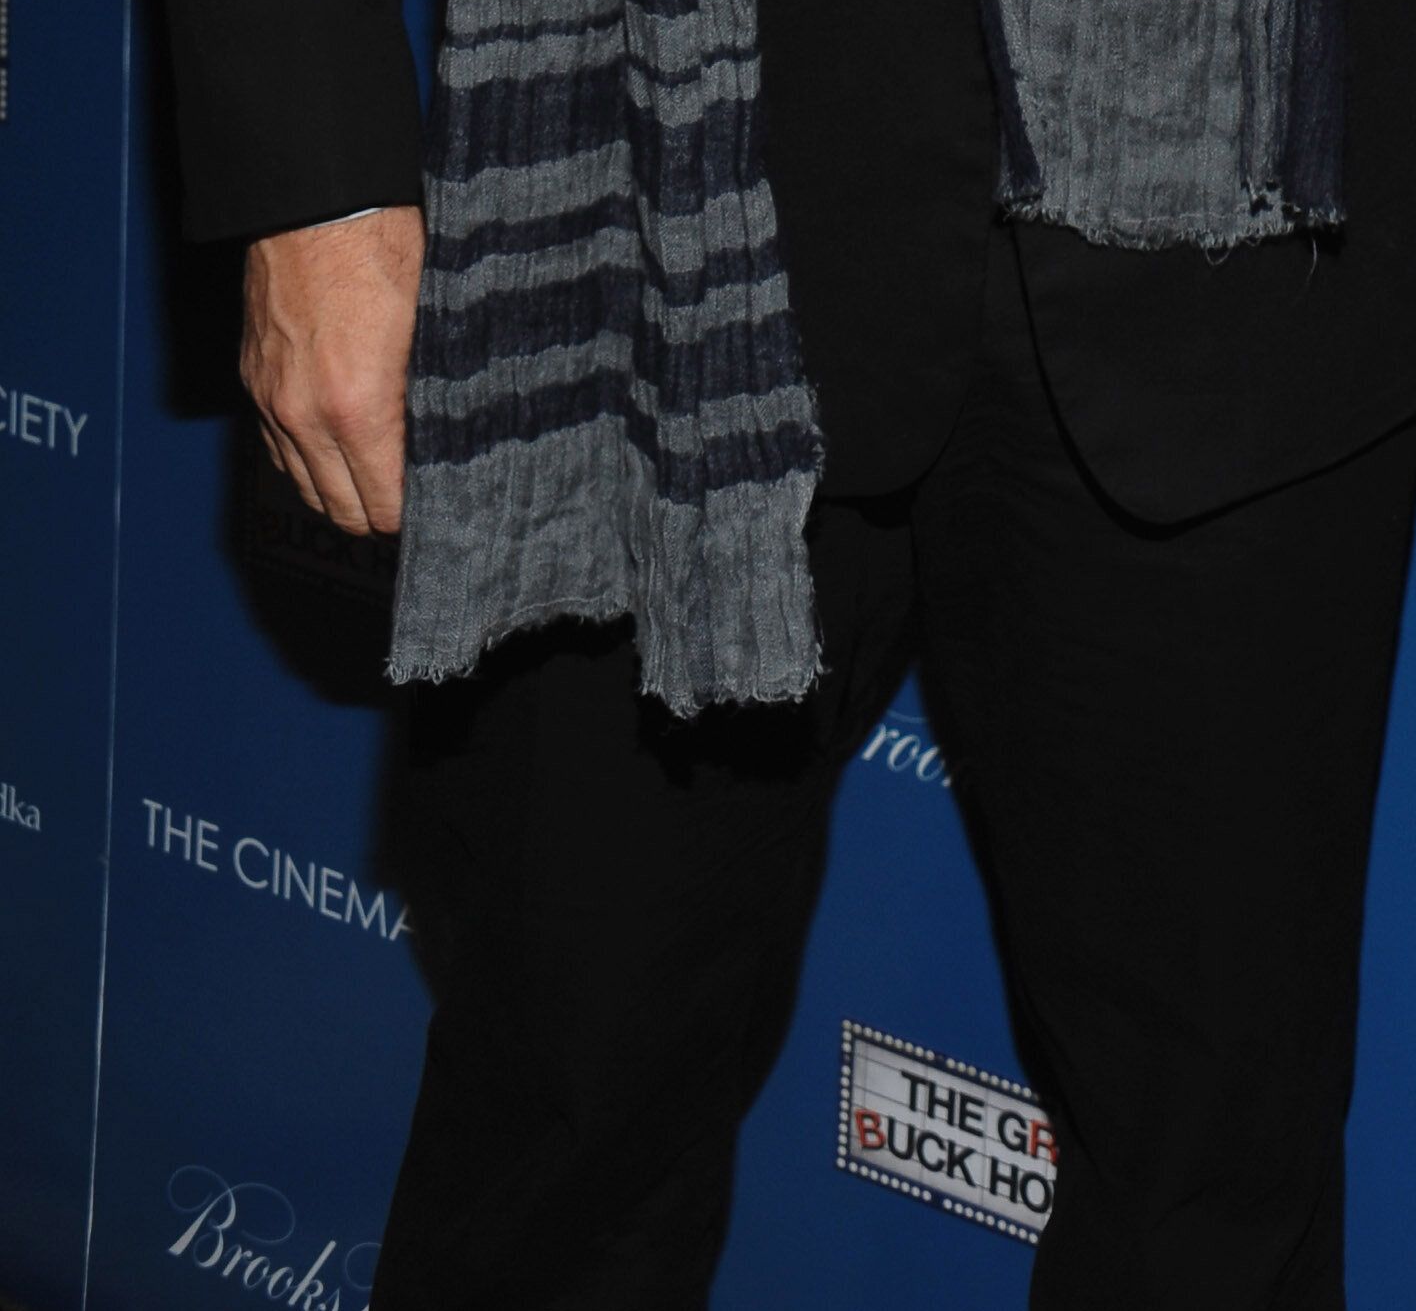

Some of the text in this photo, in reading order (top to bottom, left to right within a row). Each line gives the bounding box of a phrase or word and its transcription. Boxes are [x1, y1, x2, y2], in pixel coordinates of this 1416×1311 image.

[0, 386, 88, 457] IETY
[143, 798, 220, 872] THE
[901, 1070, 986, 1138] THE
[855, 1108, 977, 1187] BUCK
